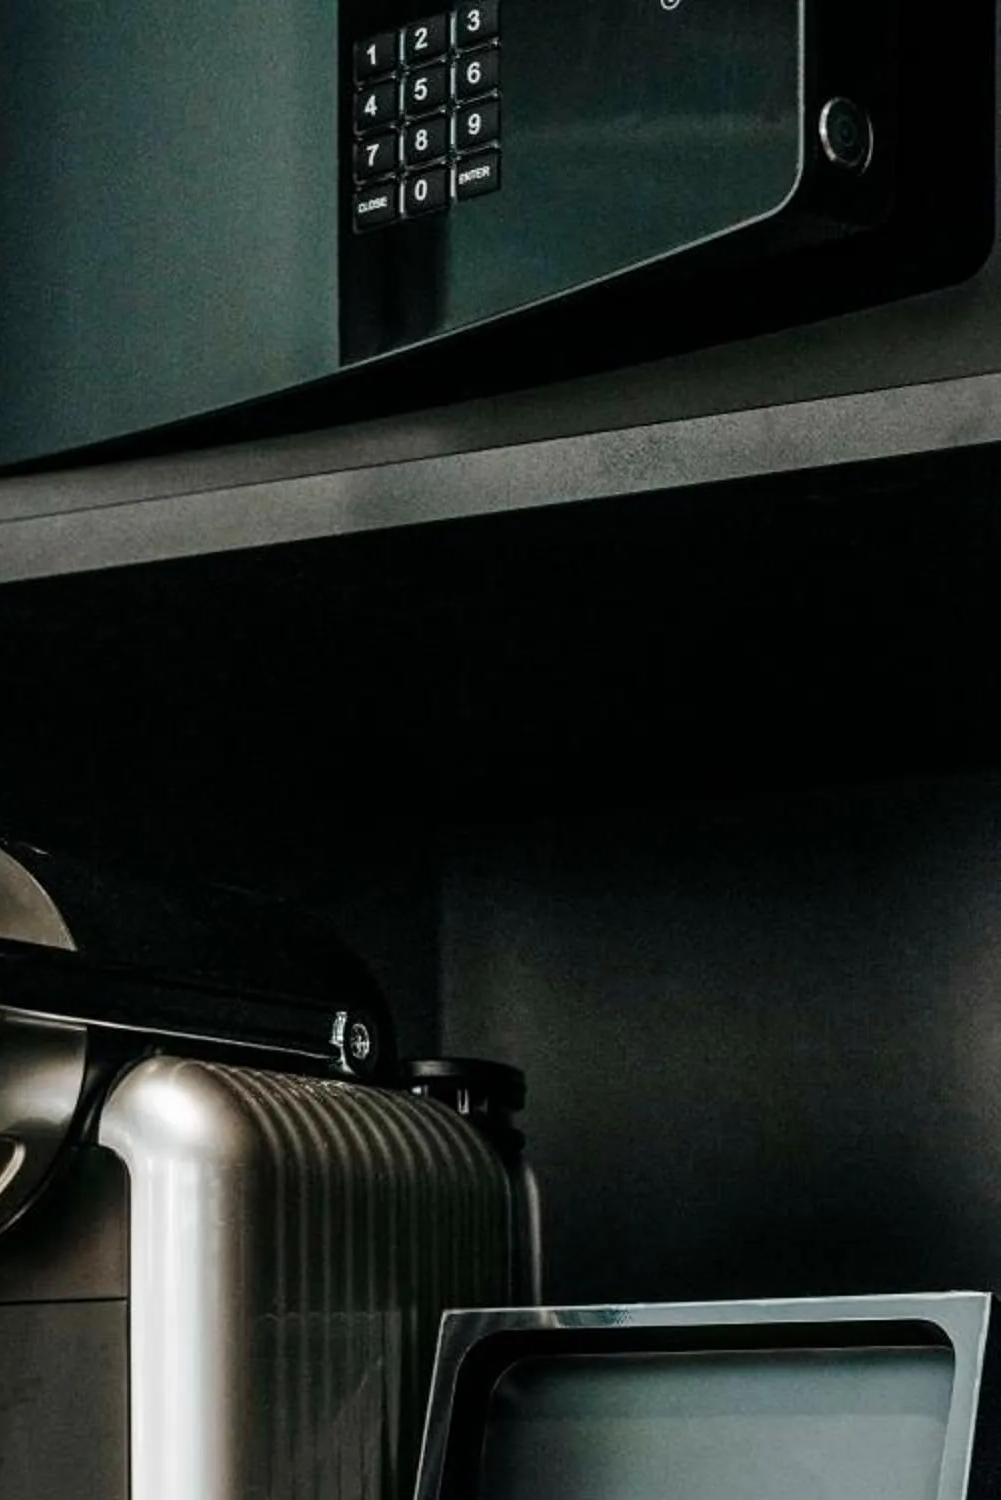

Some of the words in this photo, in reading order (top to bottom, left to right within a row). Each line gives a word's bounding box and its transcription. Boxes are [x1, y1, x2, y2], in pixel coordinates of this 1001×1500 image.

[366, 44, 377, 66] 1
[415, 27, 429, 50] 2
[466, 9, 481, 31] 3
[364, 94, 378, 117] 4
[414, 77, 428, 100] 5
[466, 61, 481, 84] 6
[366, 143, 380, 167] 7
[415, 129, 428, 150] 8
[468, 113, 482, 135] 9
[358, 197, 388, 213] CLOSE
[414, 179, 428, 201] 0
[458, 166, 490, 184] ENTER
